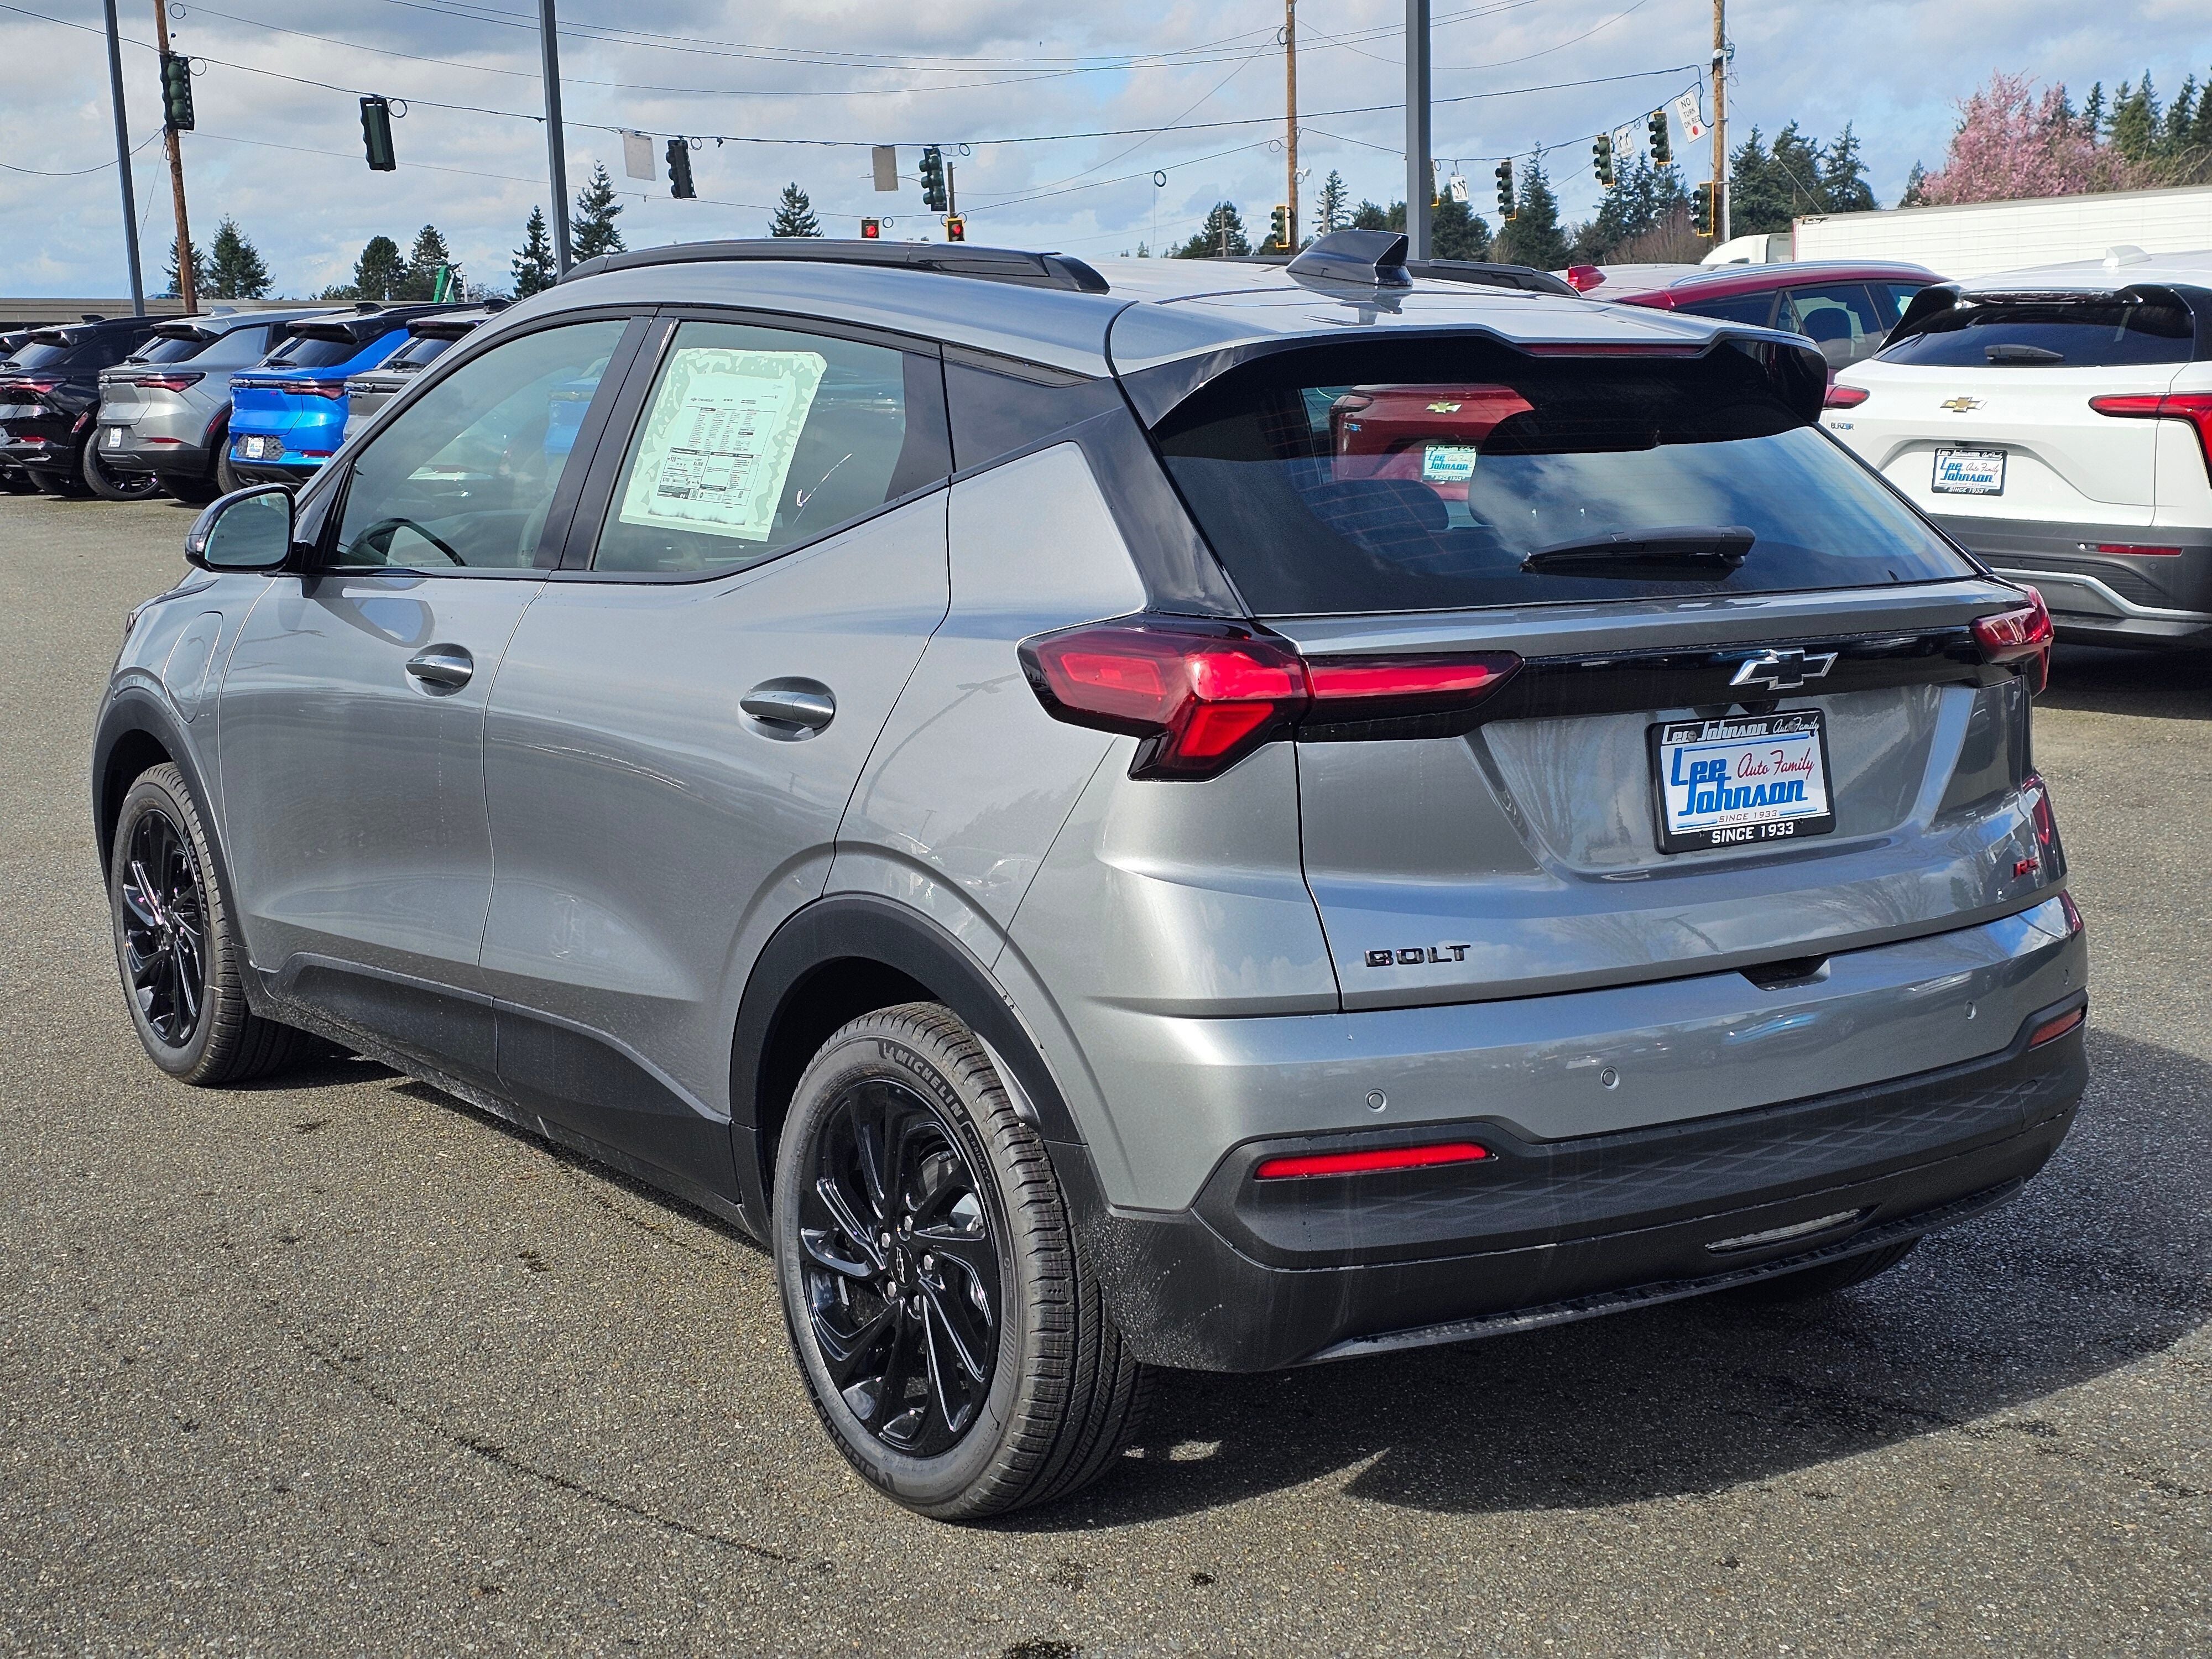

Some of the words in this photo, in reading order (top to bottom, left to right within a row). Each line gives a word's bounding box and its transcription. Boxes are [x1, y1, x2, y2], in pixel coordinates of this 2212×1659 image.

[1681, 97, 1691, 109] NO
[1683, 107, 1695, 118] TURN
[1692, 114, 1700, 124] RED
[1428, 451, 1446, 462] Lee
[1428, 459, 1469, 471] Johnson
[1940, 457, 1964, 471] Lee
[1966, 462, 1980, 471] Auto
[1981, 463, 2000, 476] Family
[1940, 468, 1995, 483] Johnson
[1697, 720, 1769, 742] Johnson
[1793, 716, 1820, 733] Family
[1671, 747, 1731, 786] Lee
[1737, 752, 1770, 778] Auto
[1770, 747, 1815, 780] Family
[1677, 773, 1808, 817] Johnson
[1718, 813, 1749, 823] SINCE
[1754, 810, 1777, 819] 1933
[1712, 826, 1755, 844] SINCE
[1761, 822, 1794, 838] 1933
[2012, 857, 2038, 879] RS
[1364, 944, 1471, 967] BOLT
[895, 1049, 963, 1118] MICHELIN
